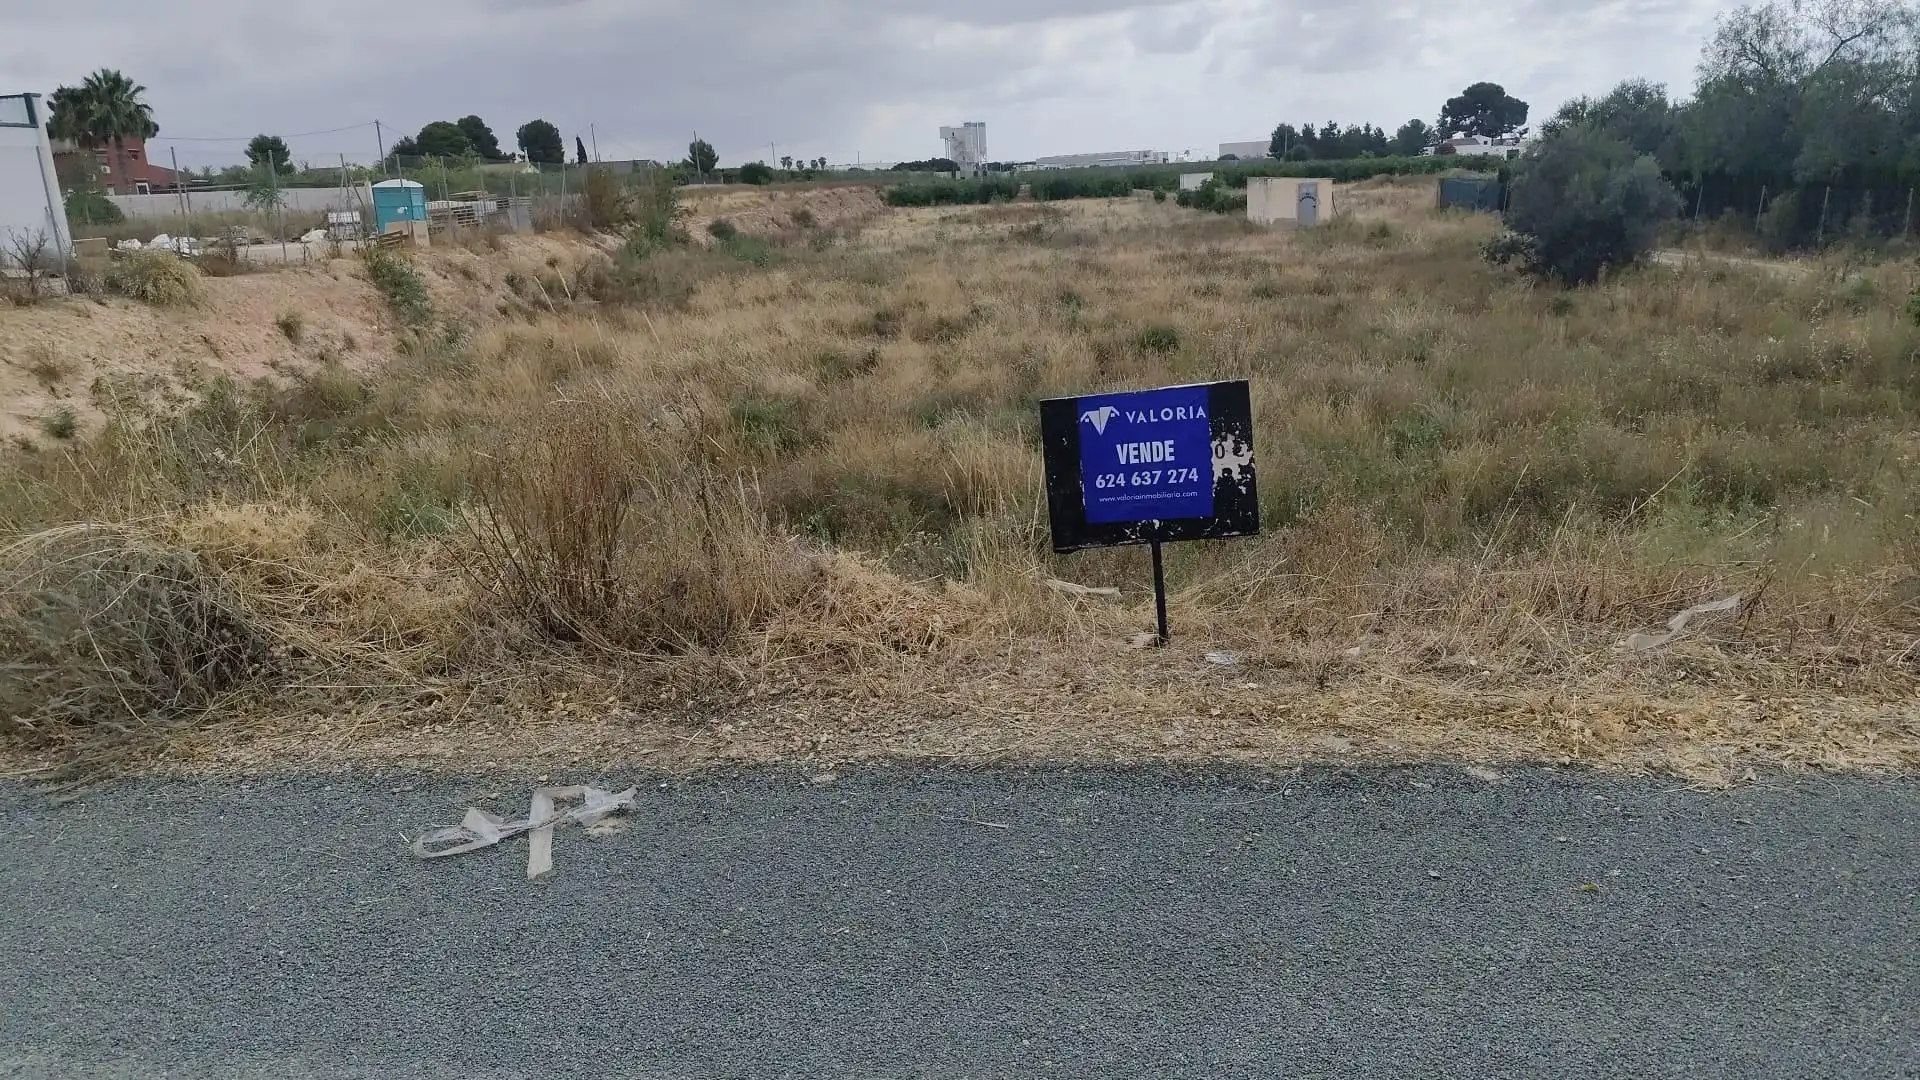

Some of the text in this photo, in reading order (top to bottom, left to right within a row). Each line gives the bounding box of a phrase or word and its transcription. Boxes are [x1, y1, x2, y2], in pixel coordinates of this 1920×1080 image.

[1126, 406, 1206, 424] VALORIA
[1116, 440, 1175, 465] VENDE
[1095, 467, 1199, 489] 624 637 274
